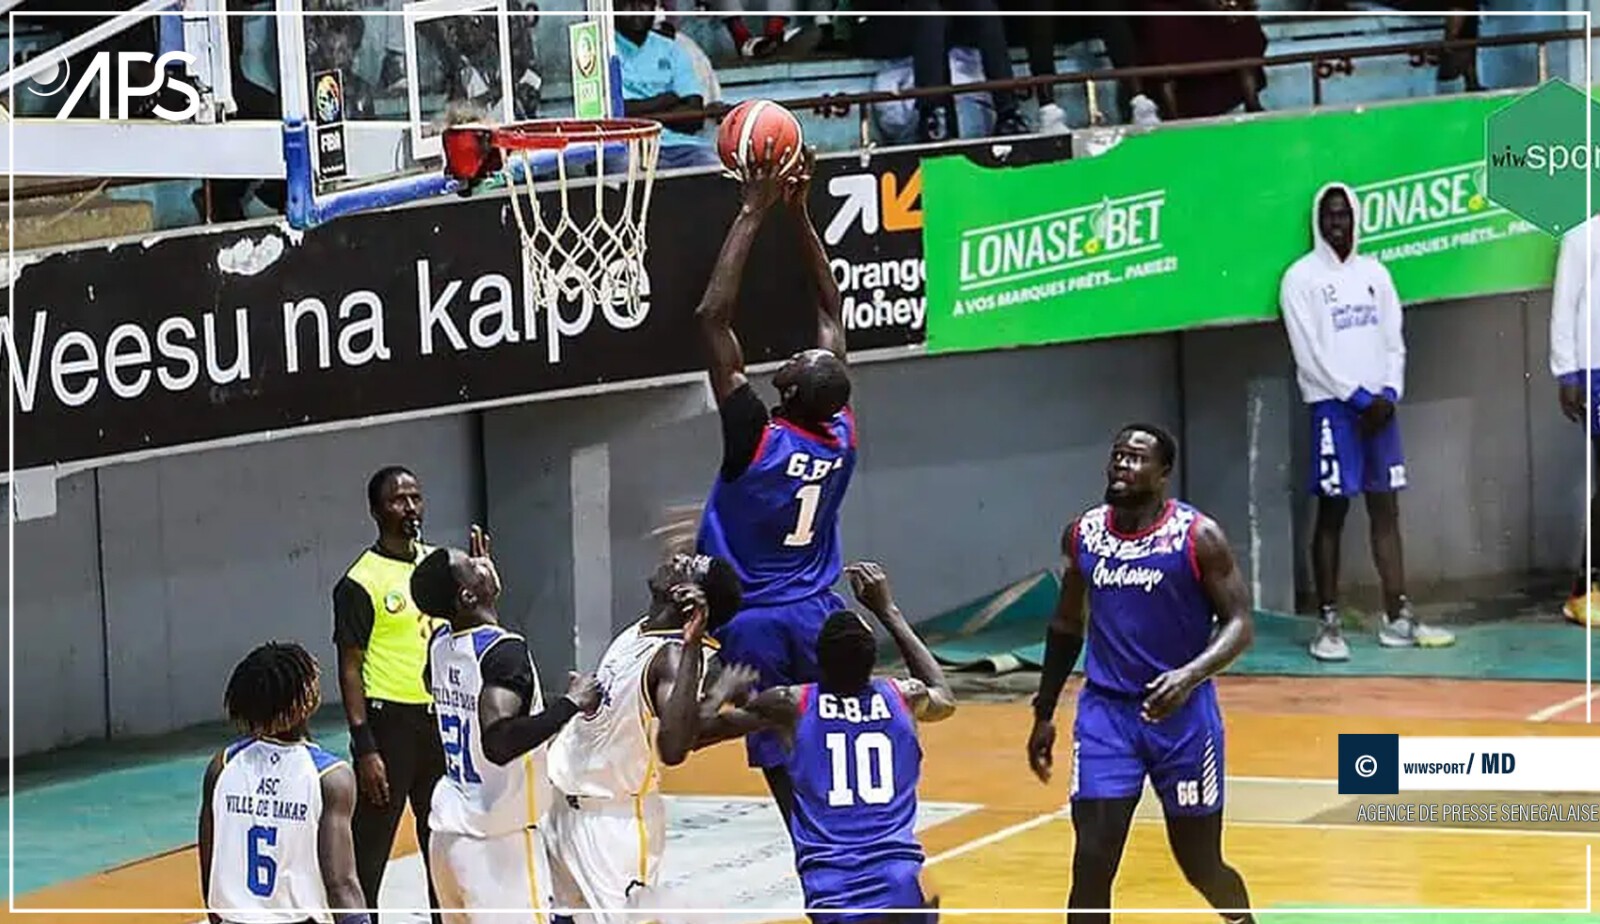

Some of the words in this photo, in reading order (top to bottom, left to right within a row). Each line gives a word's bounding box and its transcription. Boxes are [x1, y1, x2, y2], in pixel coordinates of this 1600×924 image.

[1361, 173, 1470, 233] ONASE
[960, 214, 1086, 283] LONASE
[1104, 198, 1165, 251] BET
[965, 296, 997, 314] VOS
[998, 278, 1067, 307] MARQUES
[284, 286, 390, 373] na
[783, 484, 822, 546] 1
[818, 693, 892, 724] G.B.A
[441, 713, 482, 784] 21
[825, 732, 895, 807] 10
[225, 795, 254, 816] VILLE
[256, 799, 269, 818] DE
[272, 800, 309, 822] DAKAR
[256, 777, 281, 796] ASC
[1177, 780, 1198, 807] 66
[246, 824, 279, 899] 6
